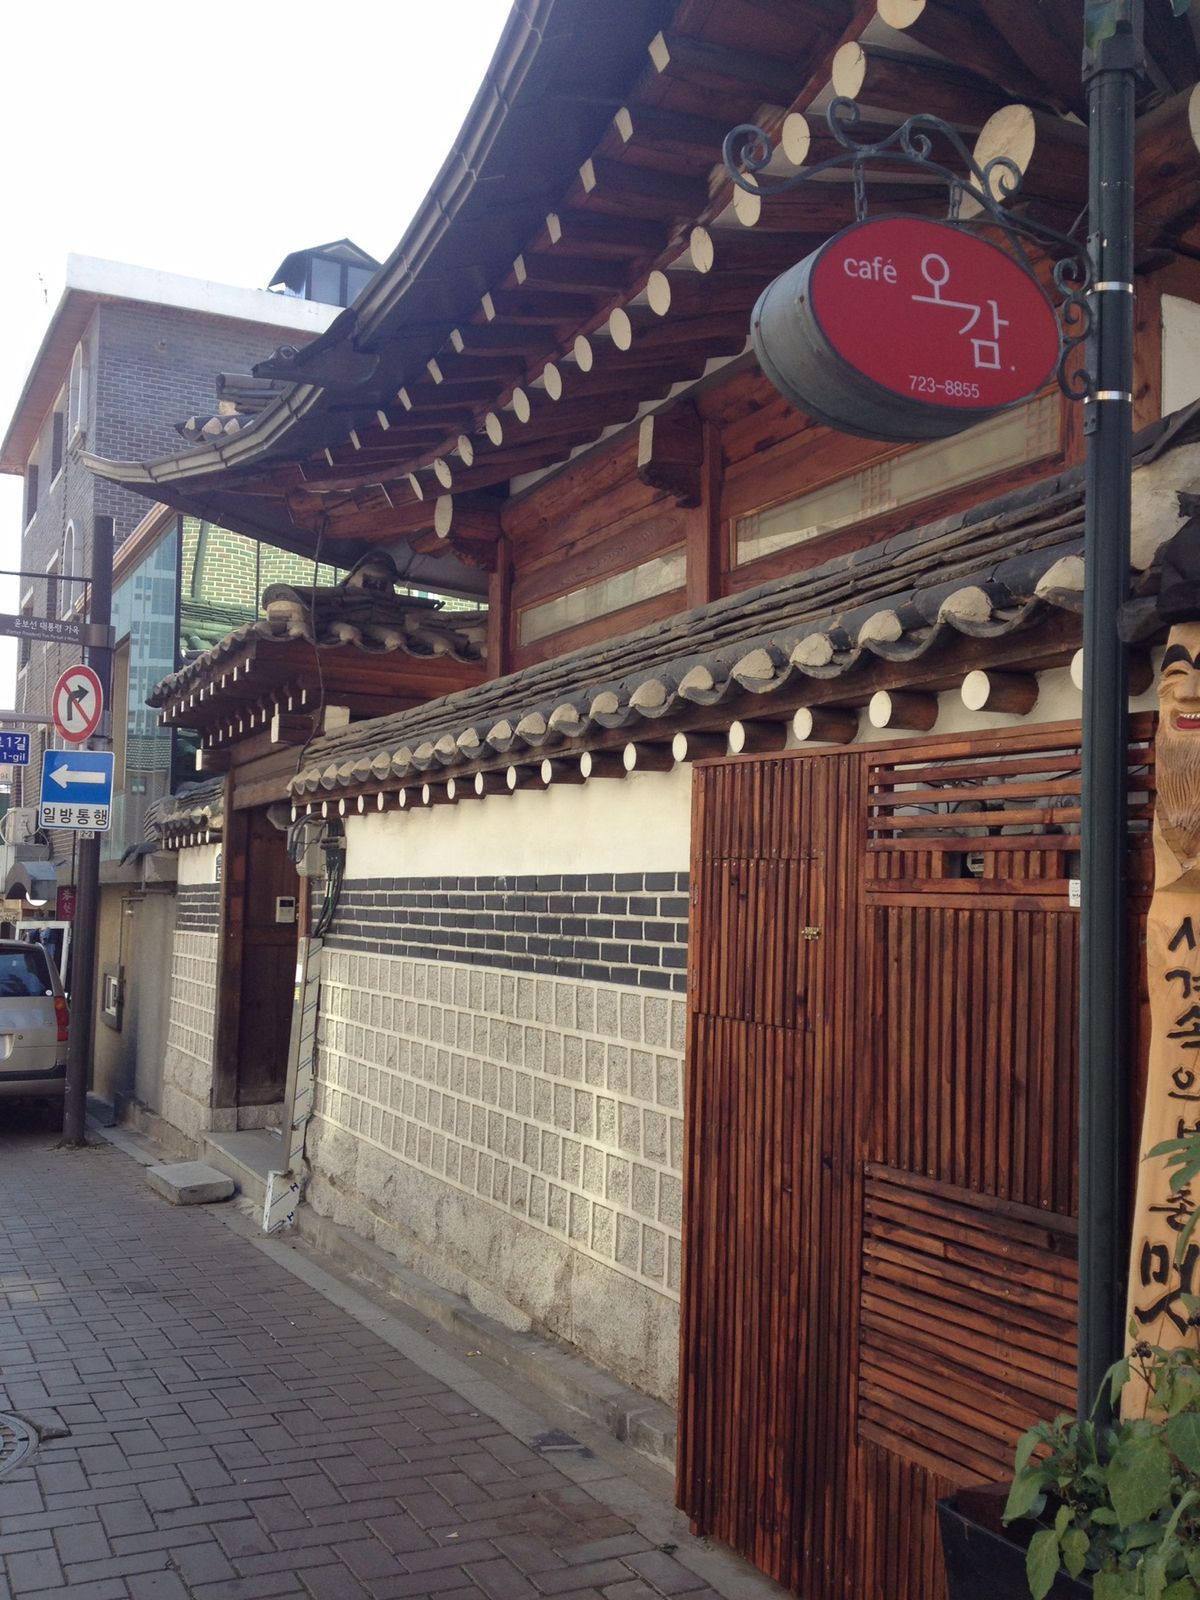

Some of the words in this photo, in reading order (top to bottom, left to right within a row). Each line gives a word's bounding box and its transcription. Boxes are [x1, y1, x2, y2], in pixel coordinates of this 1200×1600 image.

[843, 255, 897, 284] café
[908, 374, 980, 399] 723-8855
[40, 621, 62, 633] 대통령
[64, 625, 80, 635] 가옥
[3, 752, 26, 763] 1-gil
[43, 806, 107, 826] 일방통행
